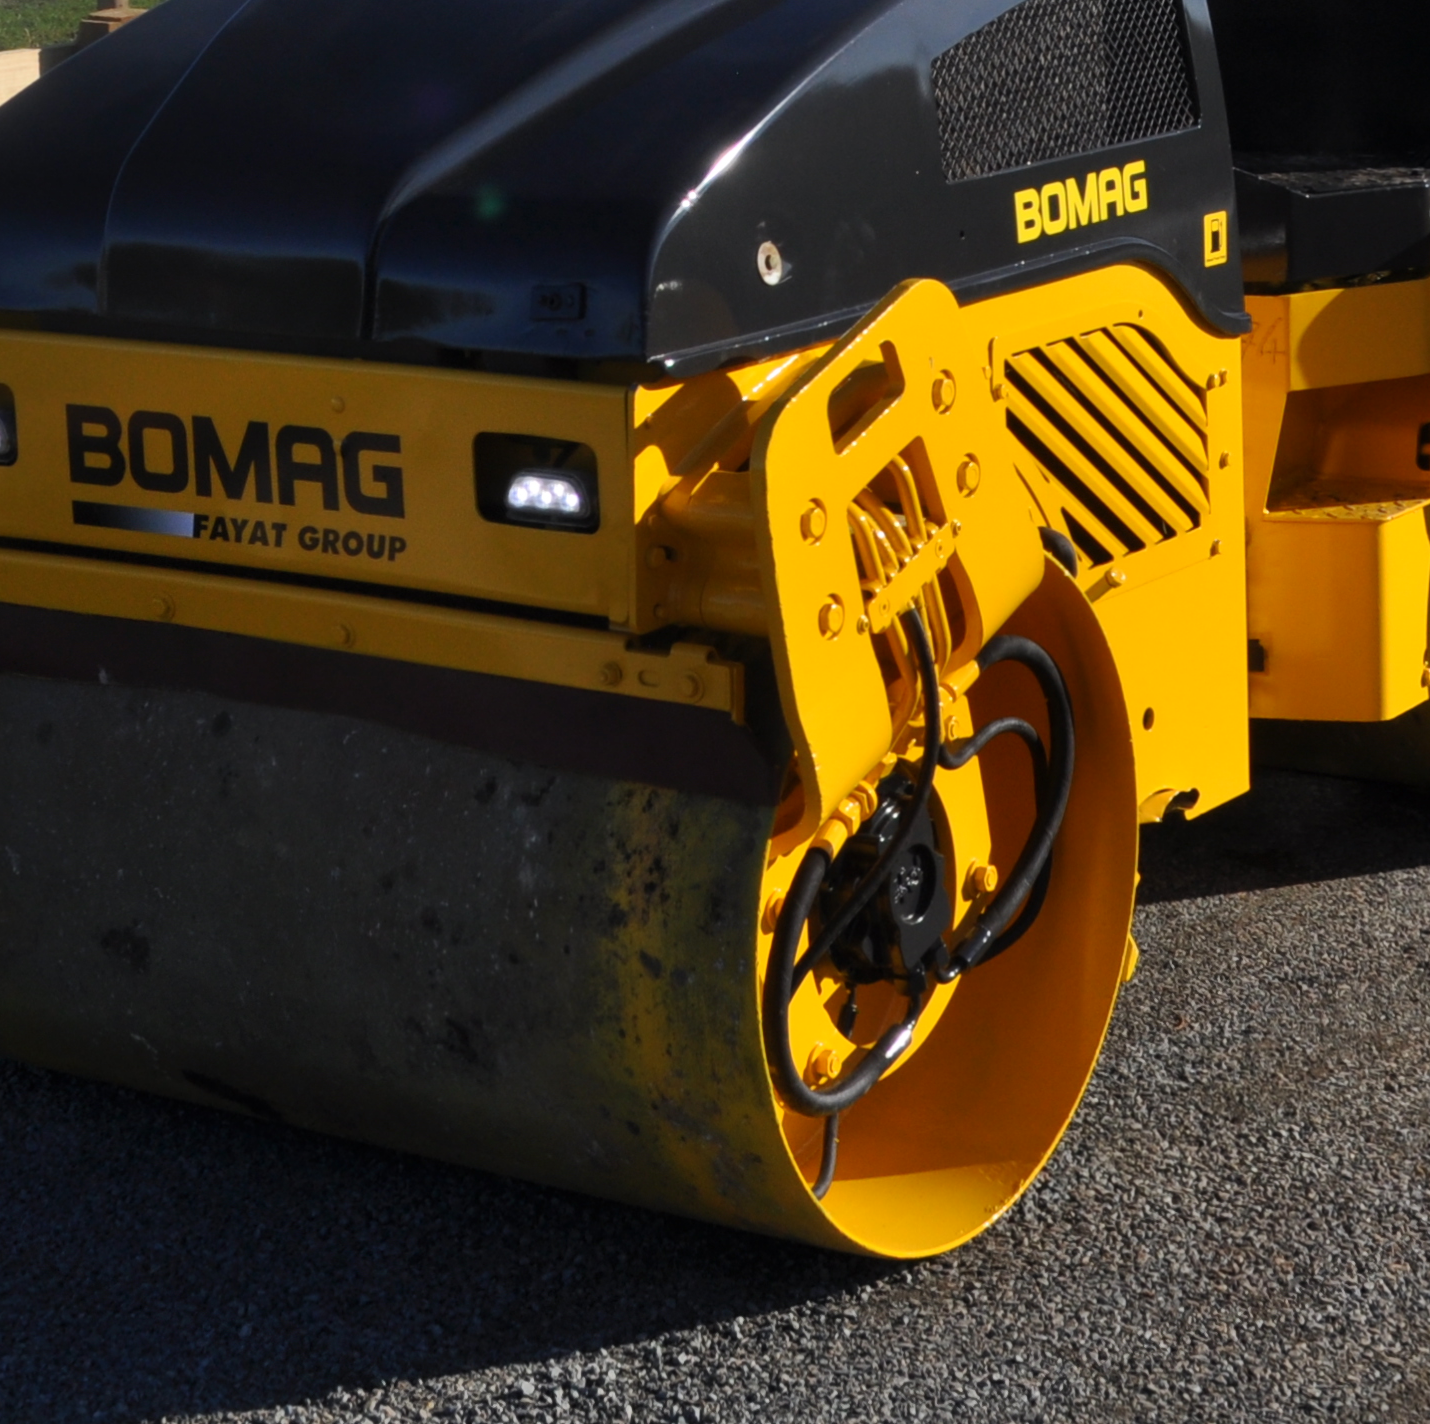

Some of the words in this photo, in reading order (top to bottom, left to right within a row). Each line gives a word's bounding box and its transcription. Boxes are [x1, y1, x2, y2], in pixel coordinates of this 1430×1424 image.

[1014, 159, 1148, 244] BOMAG
[65, 403, 405, 519] BOMAG
[193, 514, 287, 548] FAYAT
[297, 525, 407, 561] GROUP
